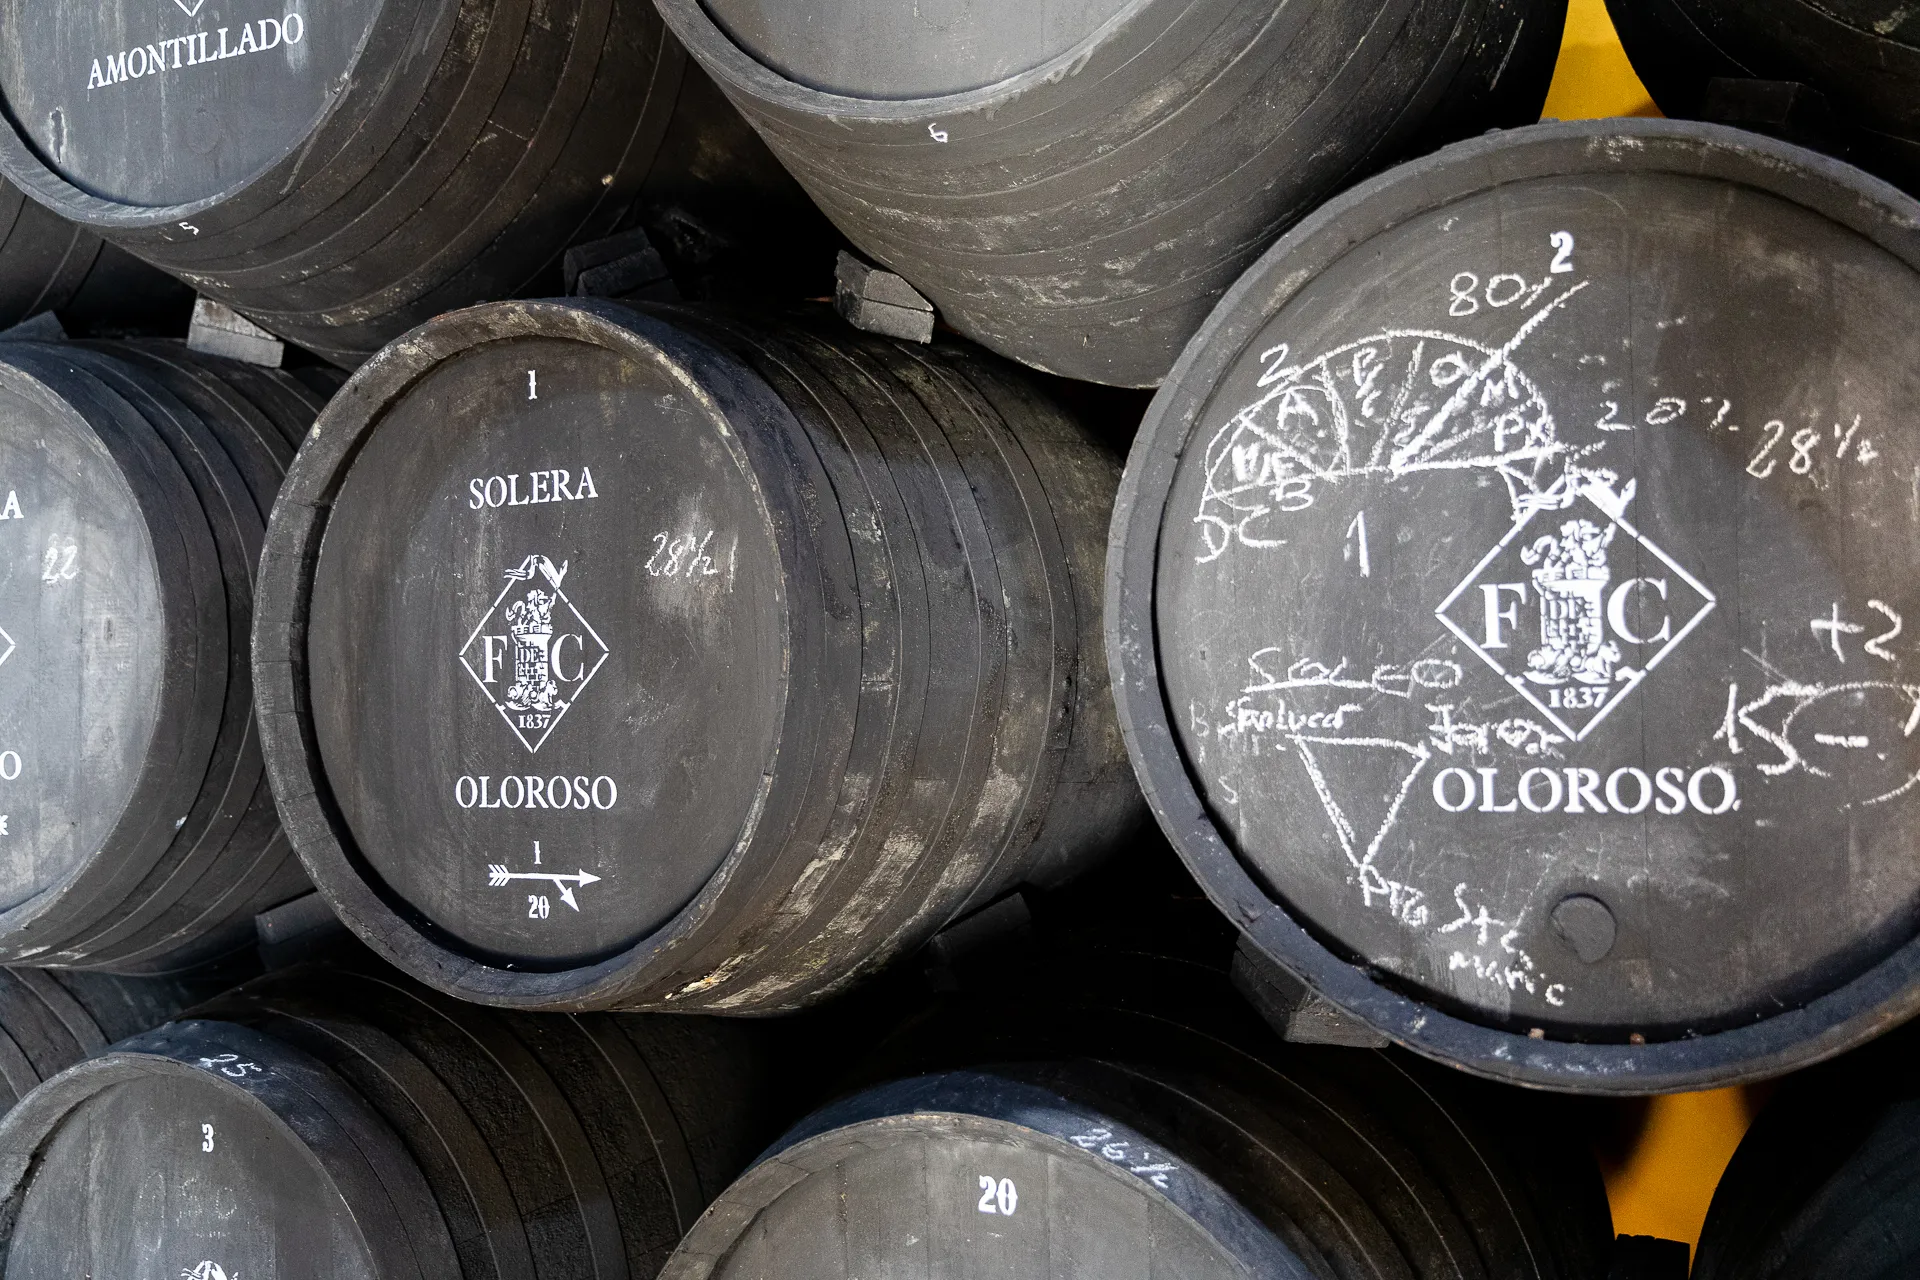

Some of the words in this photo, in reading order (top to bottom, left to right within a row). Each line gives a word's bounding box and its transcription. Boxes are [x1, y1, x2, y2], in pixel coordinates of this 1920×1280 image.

[87, 13, 304, 90] AMONTILLADO
[1549, 230, 1574, 273] 2
[527, 369, 538, 400] 1
[468, 466, 599, 510] SOLERA
[1478, 582, 1527, 649] F
[1606, 577, 1671, 644] C
[482, 635, 508, 683] F
[550, 633, 584, 682] C
[1547, 686, 1609, 709] 1837
[518, 713, 552, 729] 1837
[454, 775, 618, 810] OLOROSO
[1431, 765, 1739, 816] OLOROSO
[532, 840, 542, 865] 1
[201, 1123, 215, 1153] 3
[978, 1174, 1019, 1217] 20
